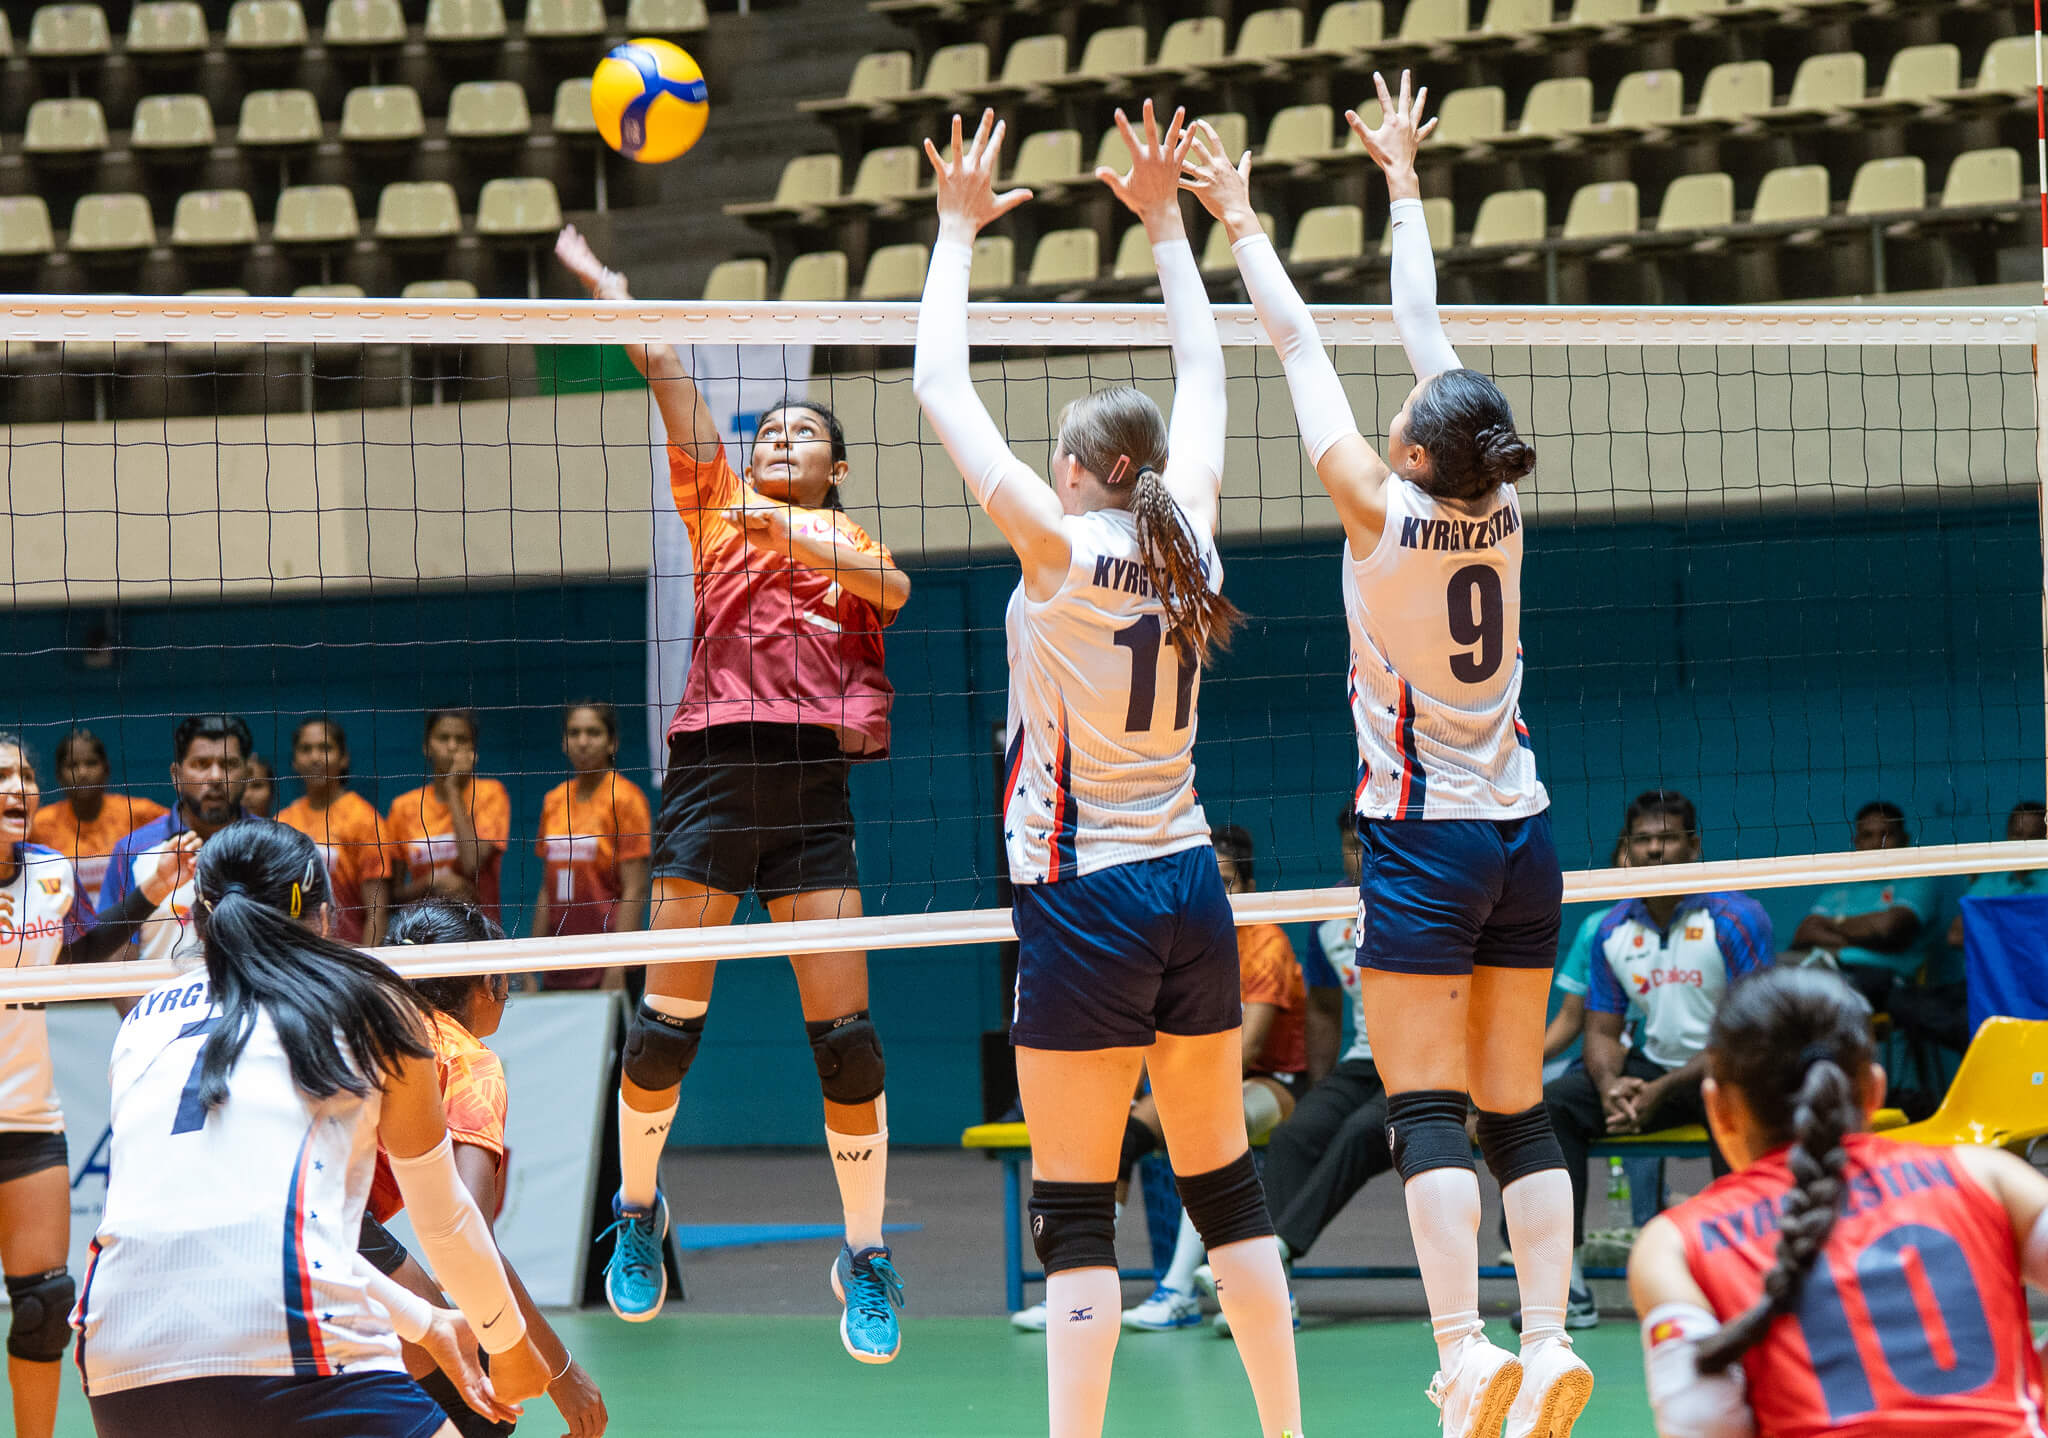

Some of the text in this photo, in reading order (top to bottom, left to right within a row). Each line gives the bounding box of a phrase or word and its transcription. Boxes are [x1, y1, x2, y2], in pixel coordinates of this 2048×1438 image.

[1446, 564, 1504, 684] 9
[170, 1016, 240, 1136] 7
[1799, 1223, 1997, 1426] 10
